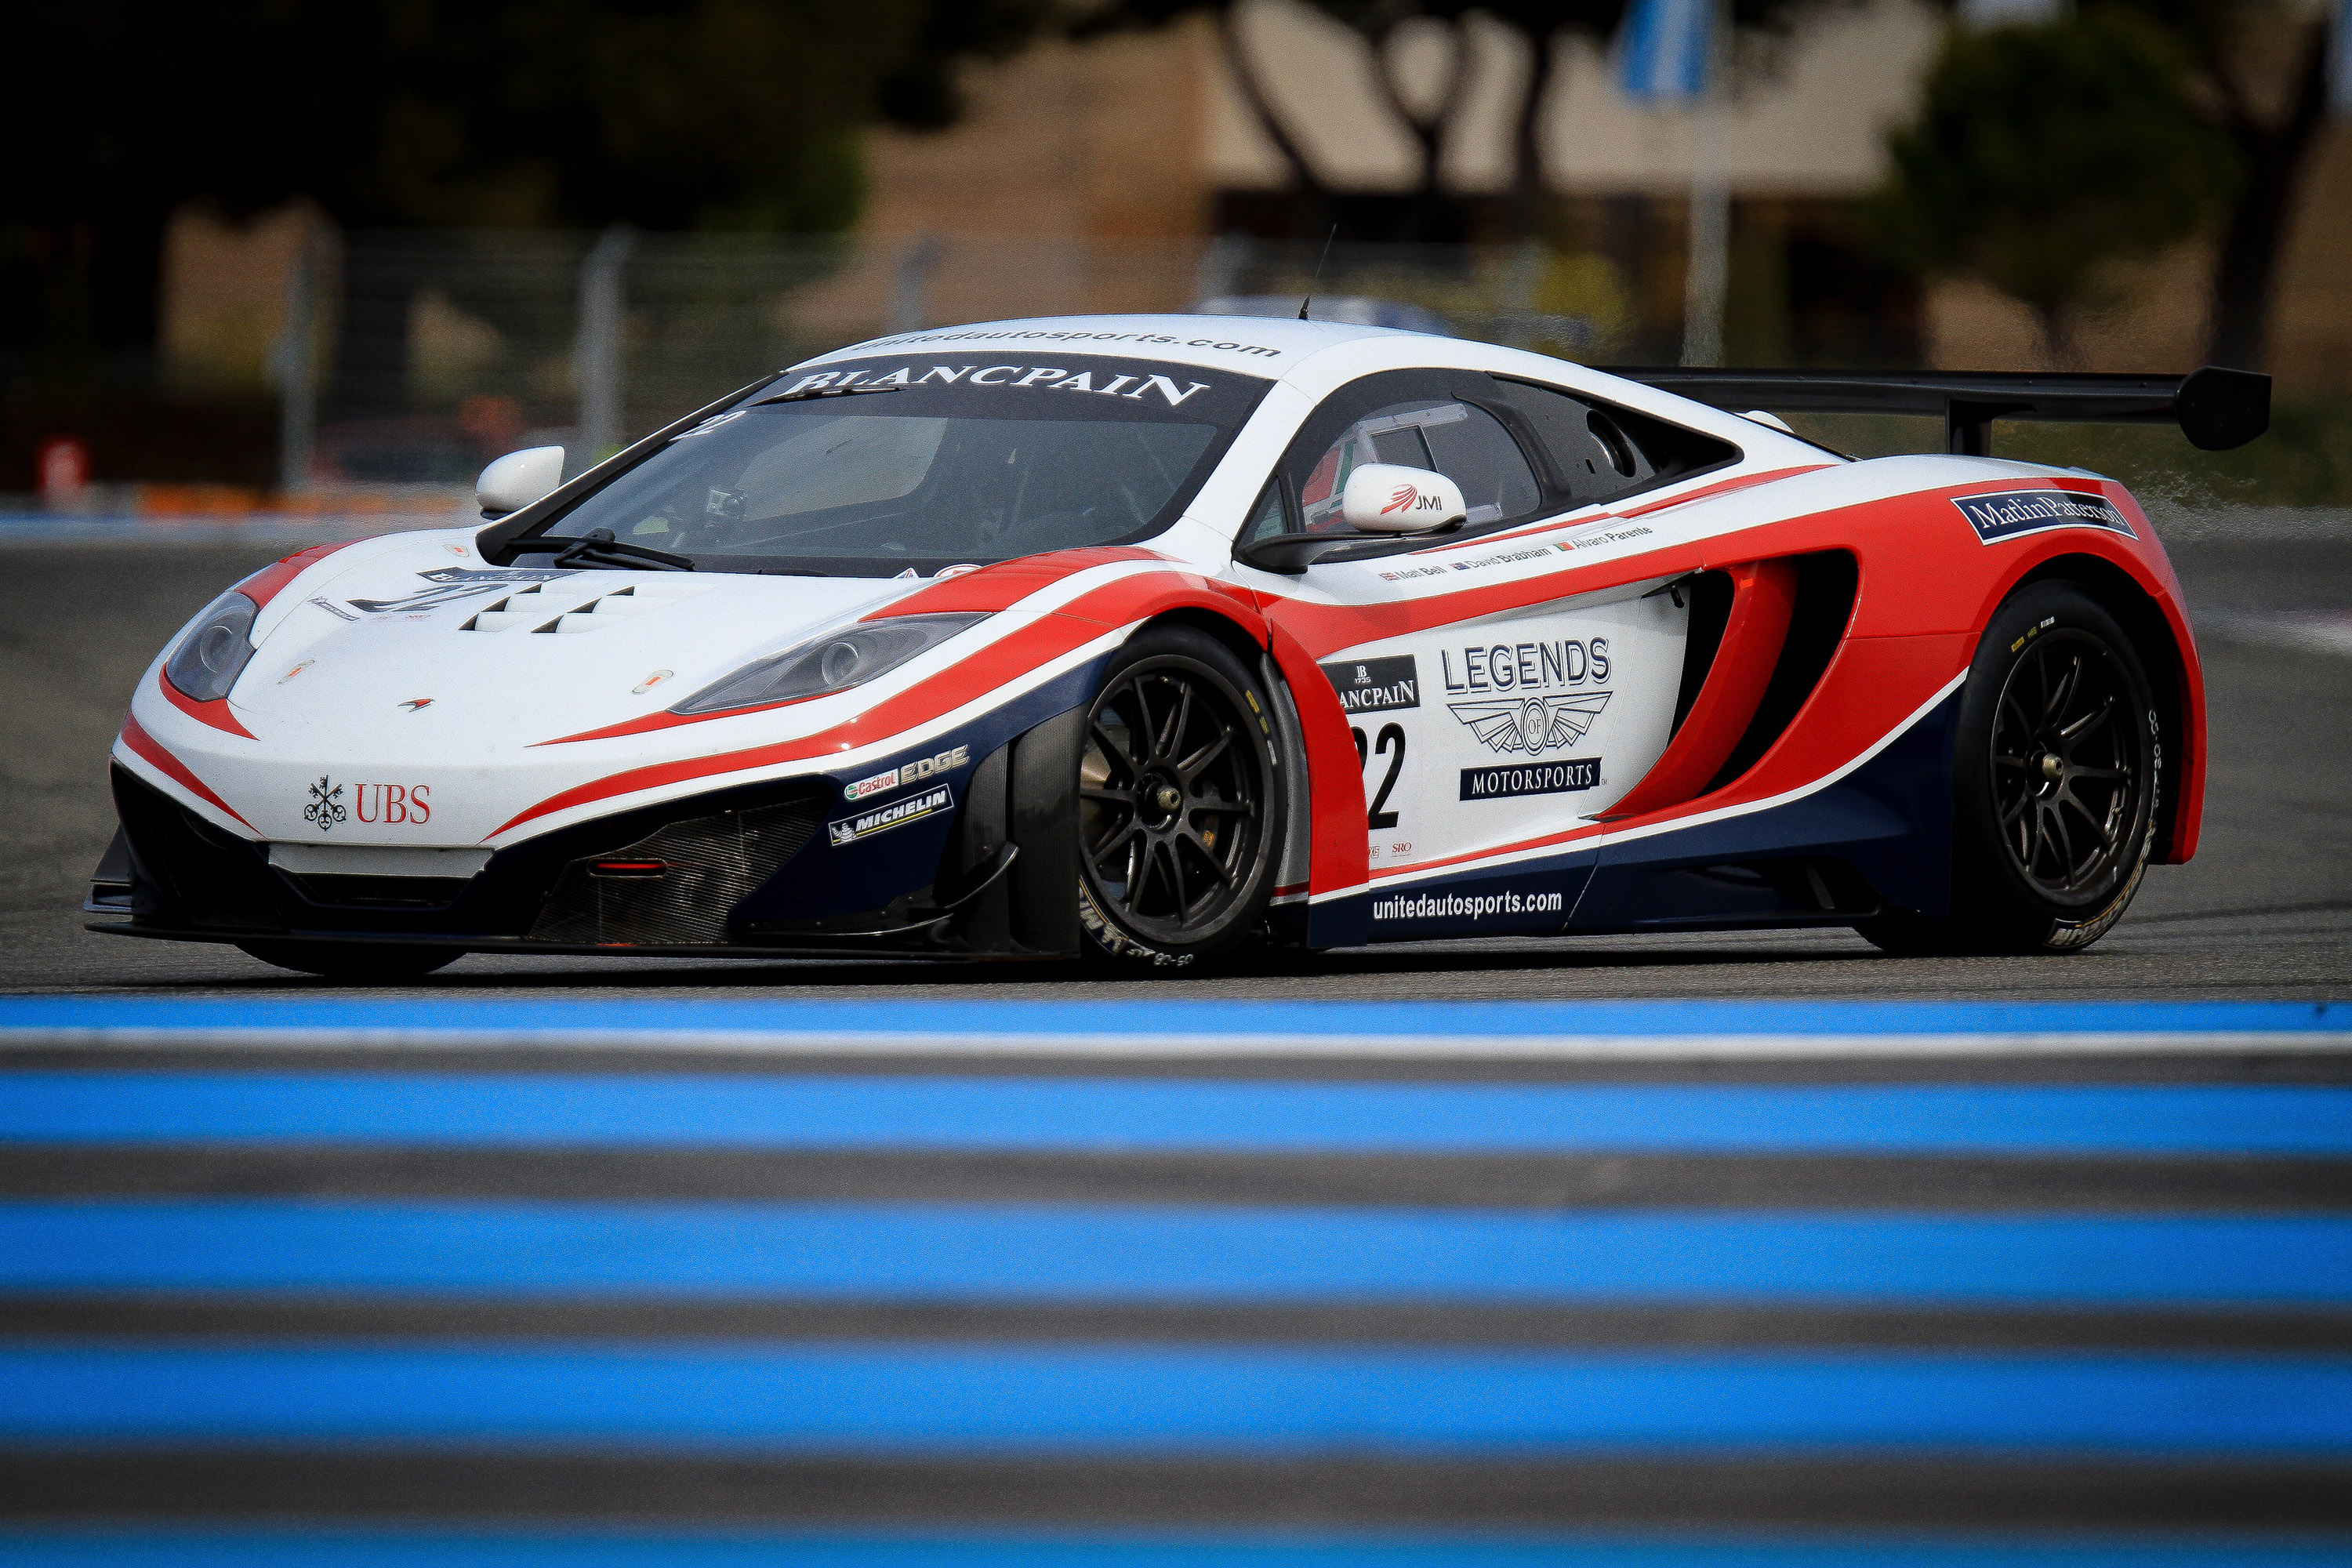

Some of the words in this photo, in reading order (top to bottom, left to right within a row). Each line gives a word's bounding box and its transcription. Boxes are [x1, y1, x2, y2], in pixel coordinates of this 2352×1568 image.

[784, 365, 1210, 406] BLANCPAIN
[1416, 495, 1443, 510] JMI
[1969, 496, 2125, 529] MatlinPatterson
[1573, 536, 1608, 550] Alvaro
[1609, 525, 1653, 543] Parente
[1399, 568, 1421, 580] Matt
[1421, 564, 1447, 575] Bell
[1467, 557, 1498, 568] David
[1497, 548, 1552, 564] Brabham
[1441, 637, 1612, 695] LEGENDS
[1339, 680, 1414, 709] ANCPAIN
[1529, 718, 1541, 735] OF
[858, 771, 895, 795] Castrol
[901, 744, 970, 784] EDGE
[1472, 764, 1592, 795] MOTORSPORTS
[354, 784, 430, 825] UBS
[855, 790, 946, 831] MICHELIN
[1392, 842, 1412, 853] SRO
[1373, 889, 1563, 920] unitedautosports.com
